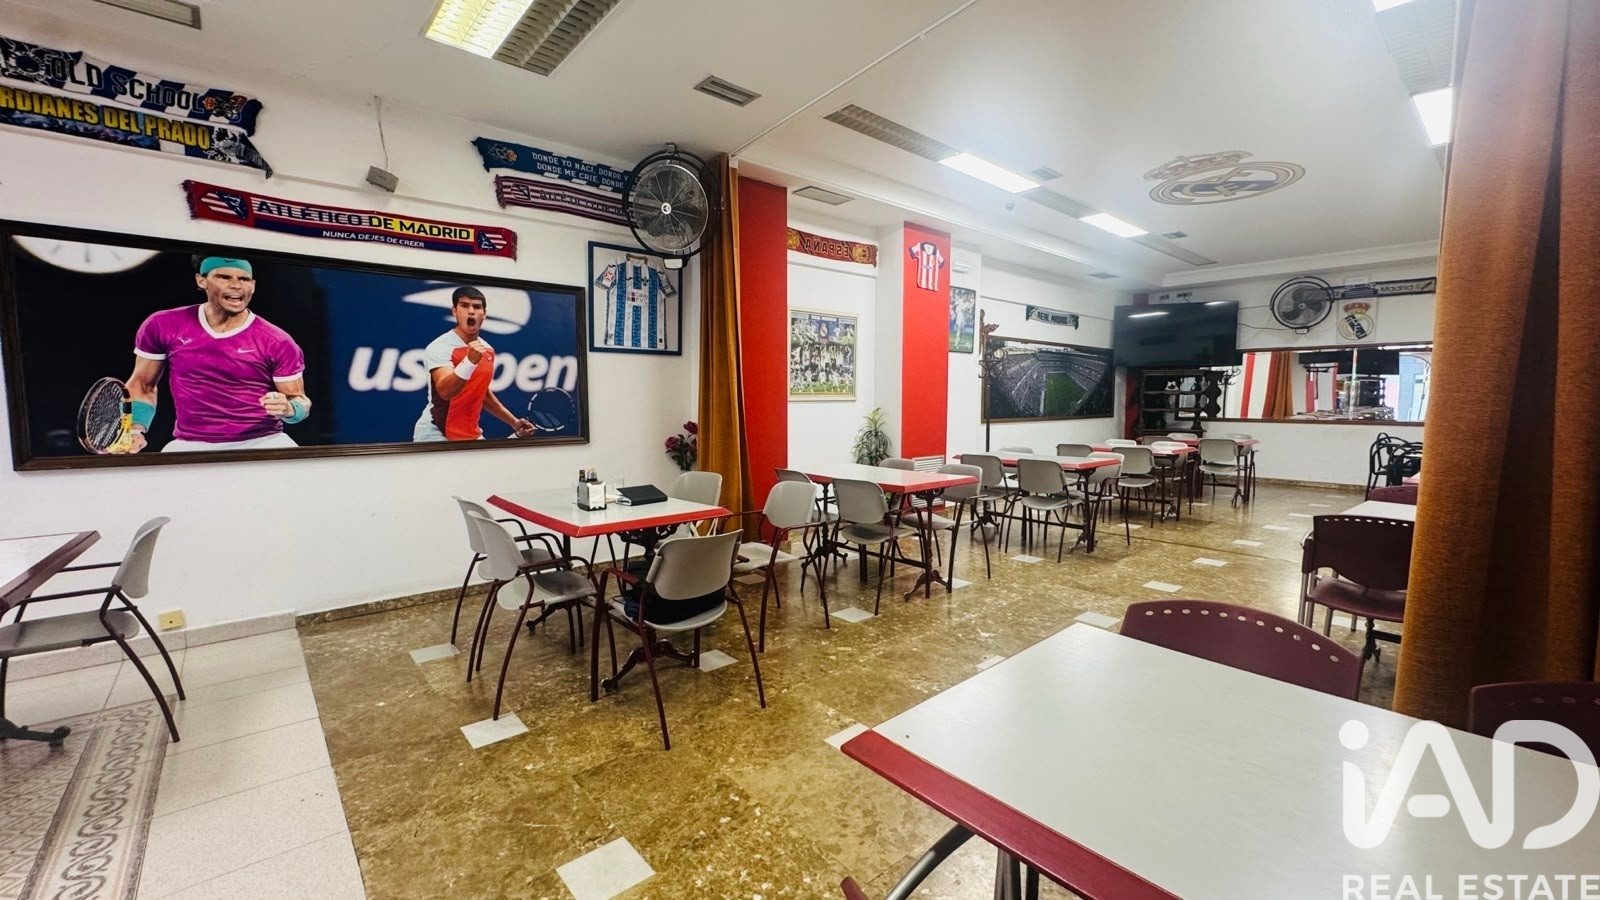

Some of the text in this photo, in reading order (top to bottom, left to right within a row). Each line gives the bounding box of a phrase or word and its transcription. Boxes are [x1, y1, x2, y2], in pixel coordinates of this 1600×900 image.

[51, 56, 205, 114] OLD SCHOOL
[103, 106, 140, 133] DEL
[143, 115, 210, 150] PRADO
[531, 152, 559, 165] DONDE
[561, 158, 572, 168] YO
[598, 167, 622, 180] DONDE
[536, 162, 562, 174] DONDE
[564, 169, 576, 177] ME
[601, 178, 624, 189] DONDE
[322, 230, 425, 248] NUNCA DEJES DE CREER
[368, 215, 394, 231] DE
[399, 220, 471, 240] MADRID
[348, 346, 428, 392] us
